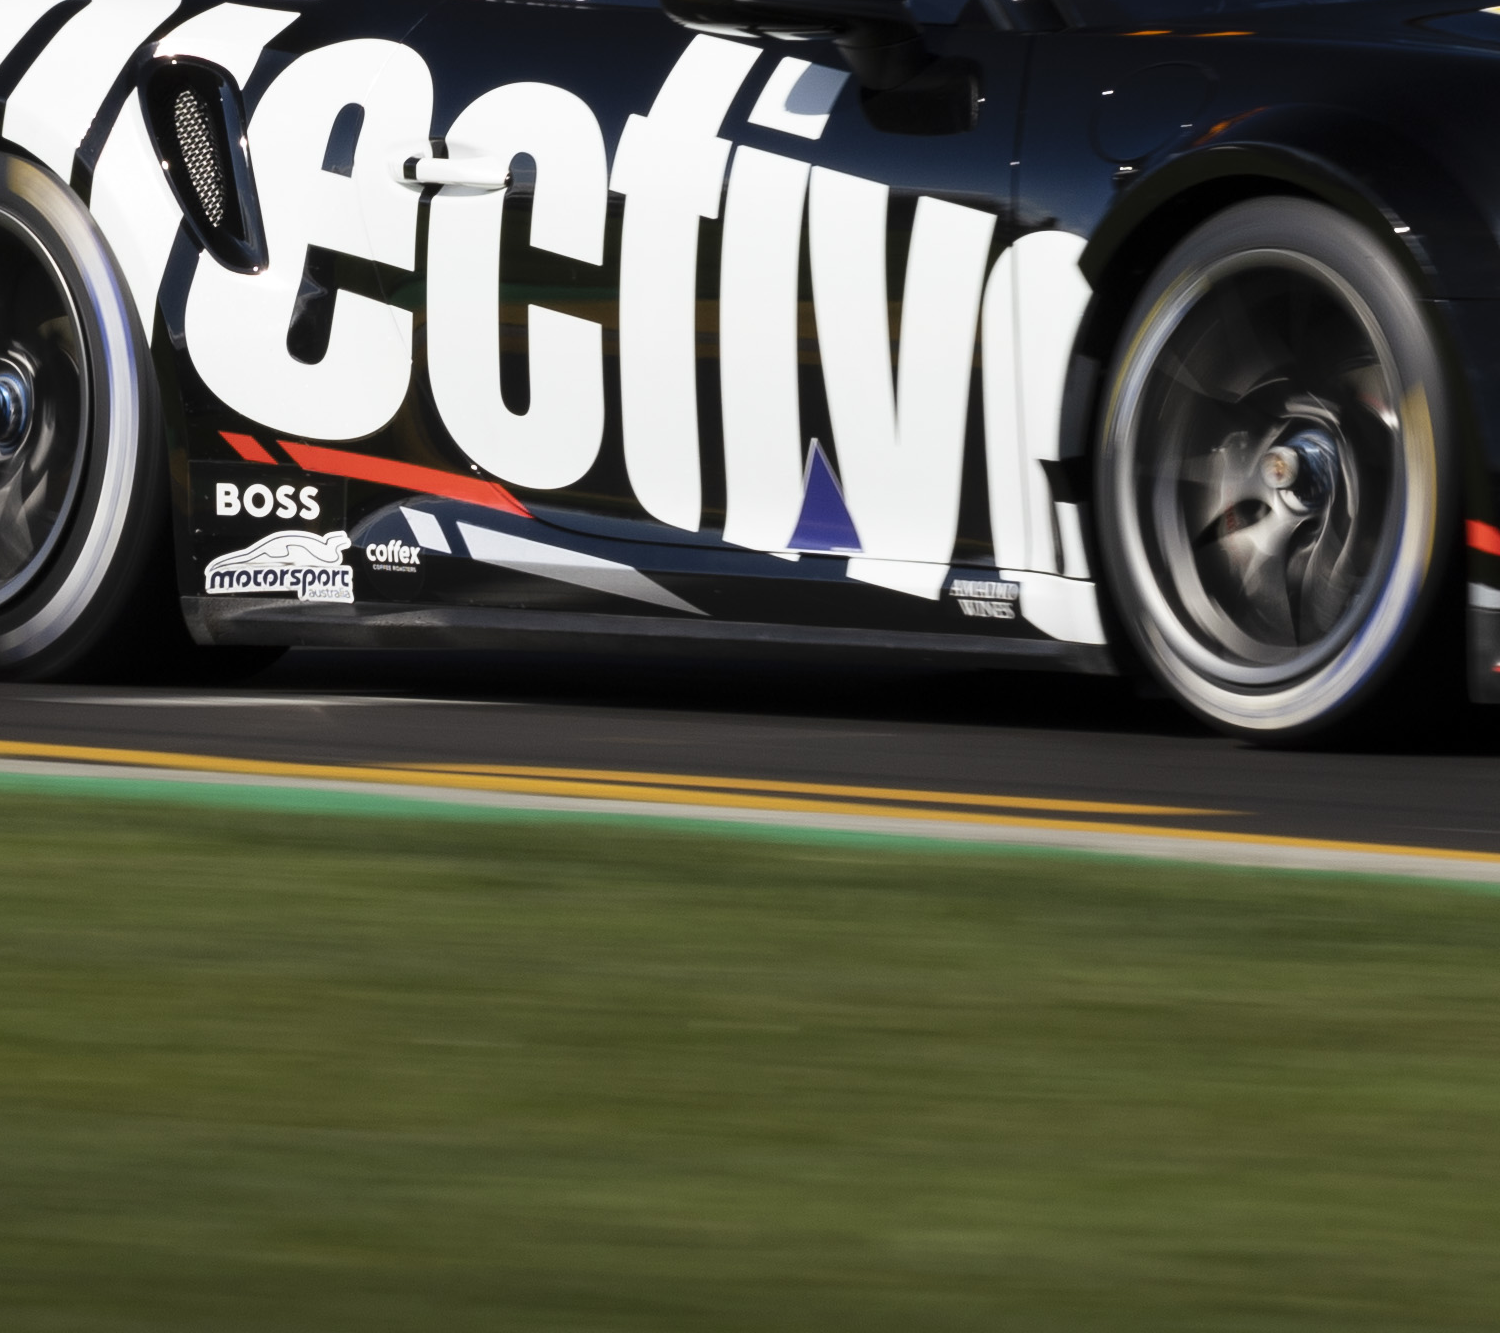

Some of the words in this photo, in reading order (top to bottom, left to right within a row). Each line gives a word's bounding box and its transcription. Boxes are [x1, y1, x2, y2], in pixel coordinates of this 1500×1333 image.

[215, 482, 321, 521] BOSS
[366, 539, 421, 565] coffex
[209, 568, 350, 598] motorsport
[307, 586, 352, 600] australia
